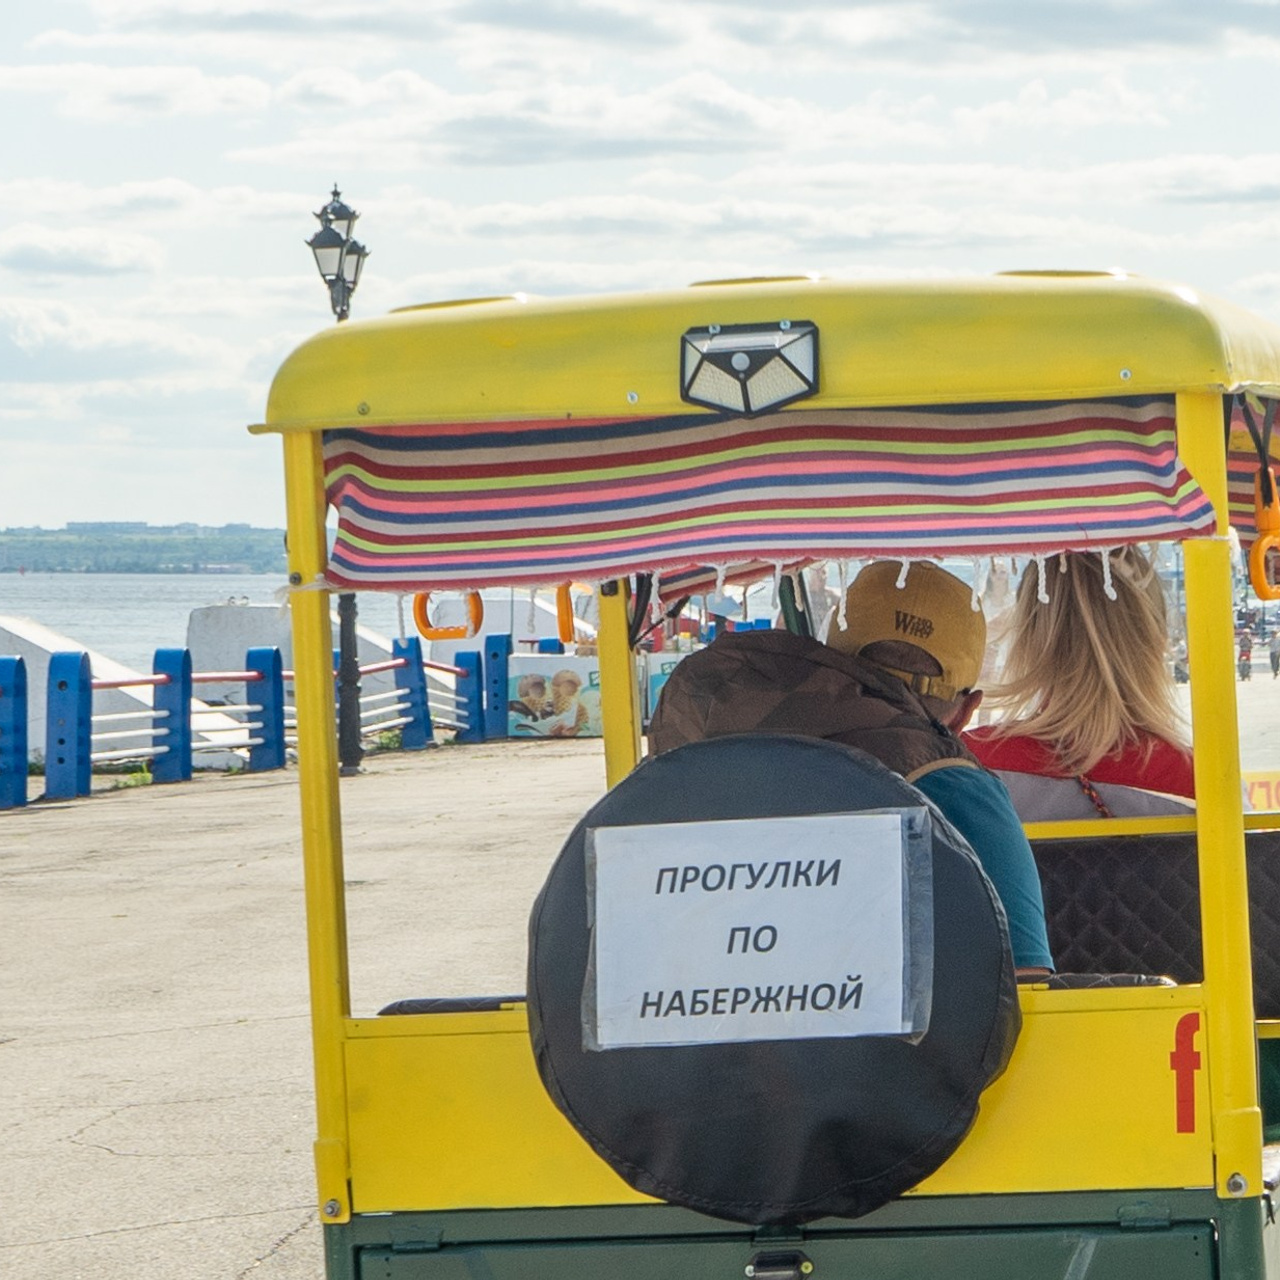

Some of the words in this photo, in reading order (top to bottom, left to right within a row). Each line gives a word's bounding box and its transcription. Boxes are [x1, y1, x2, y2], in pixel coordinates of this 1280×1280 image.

[654, 859, 841, 895] ПРОГУЛКИ
[726, 925, 778, 954] ПО
[640, 974, 863, 1018] НАБЕРЖНОЙ
